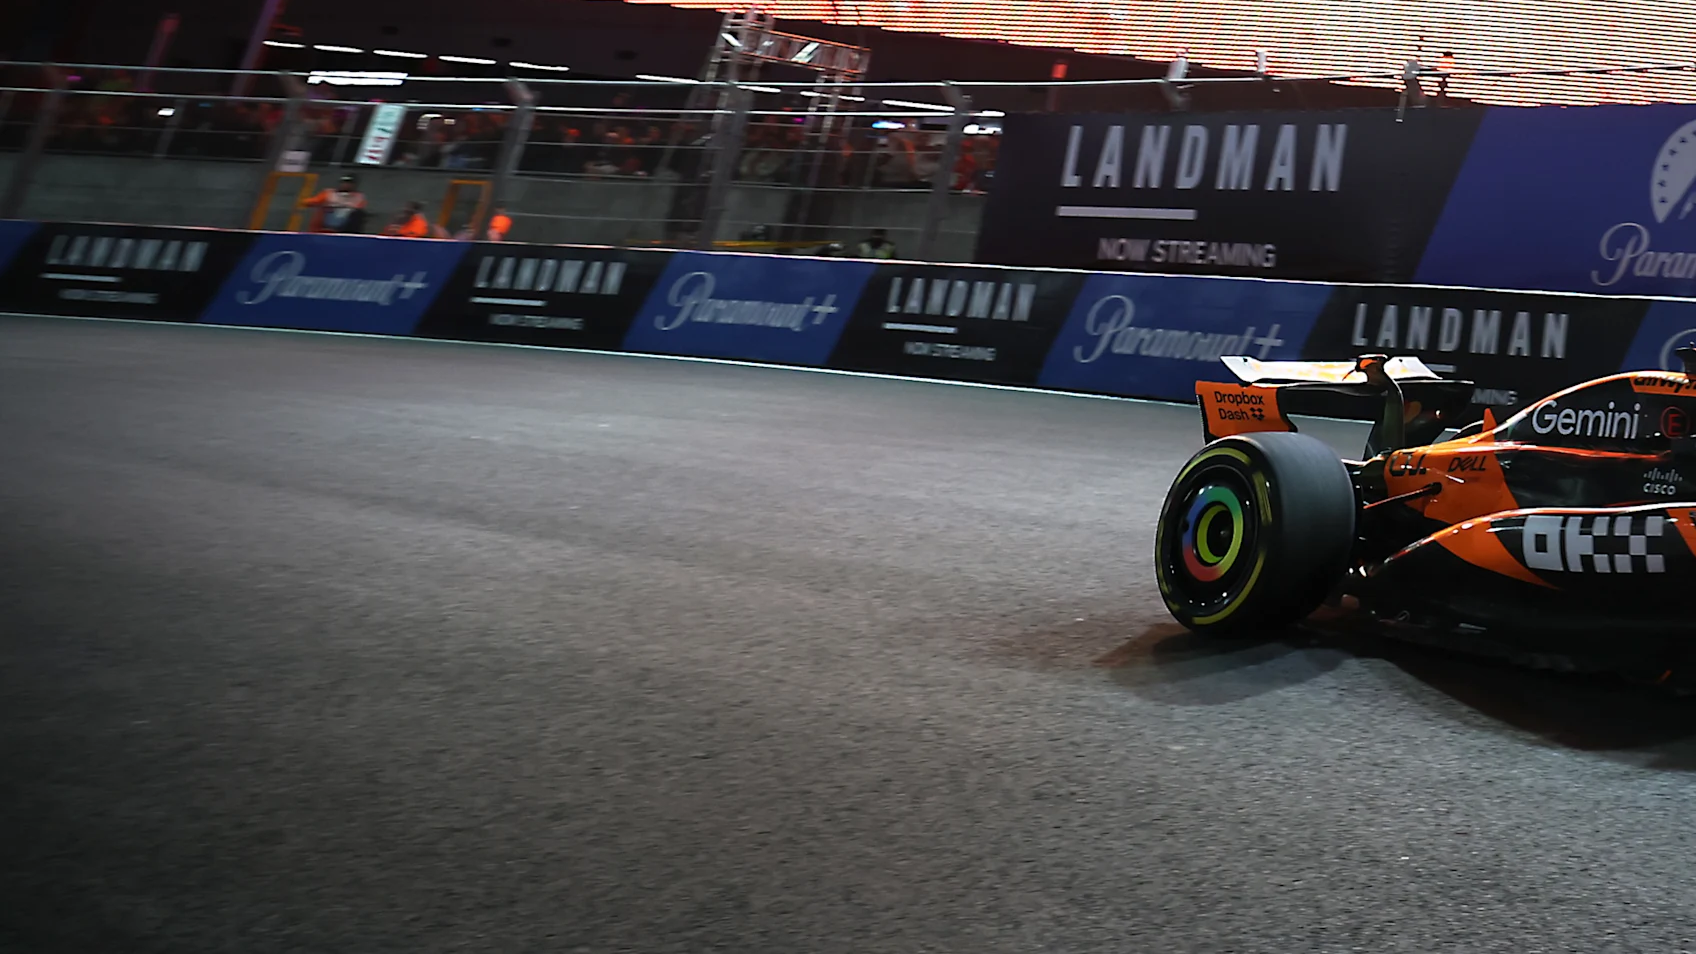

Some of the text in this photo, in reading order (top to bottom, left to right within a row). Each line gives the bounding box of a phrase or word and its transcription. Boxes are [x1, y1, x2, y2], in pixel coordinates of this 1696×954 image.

[1060, 124, 1348, 191] LANDMAN
[1097, 238, 1277, 268] NOW STREAMING
[473, 256, 628, 295] LANDMAN
[886, 277, 1037, 322] LANDMAN
[1351, 303, 1569, 359] LANDMAN
[1213, 391, 1265, 406] Dropbox
[1218, 408, 1250, 421] Dash
[1532, 399, 1642, 440] Gemini
[1447, 455, 1488, 473] DELL
[1522, 515, 1666, 573] OKX
